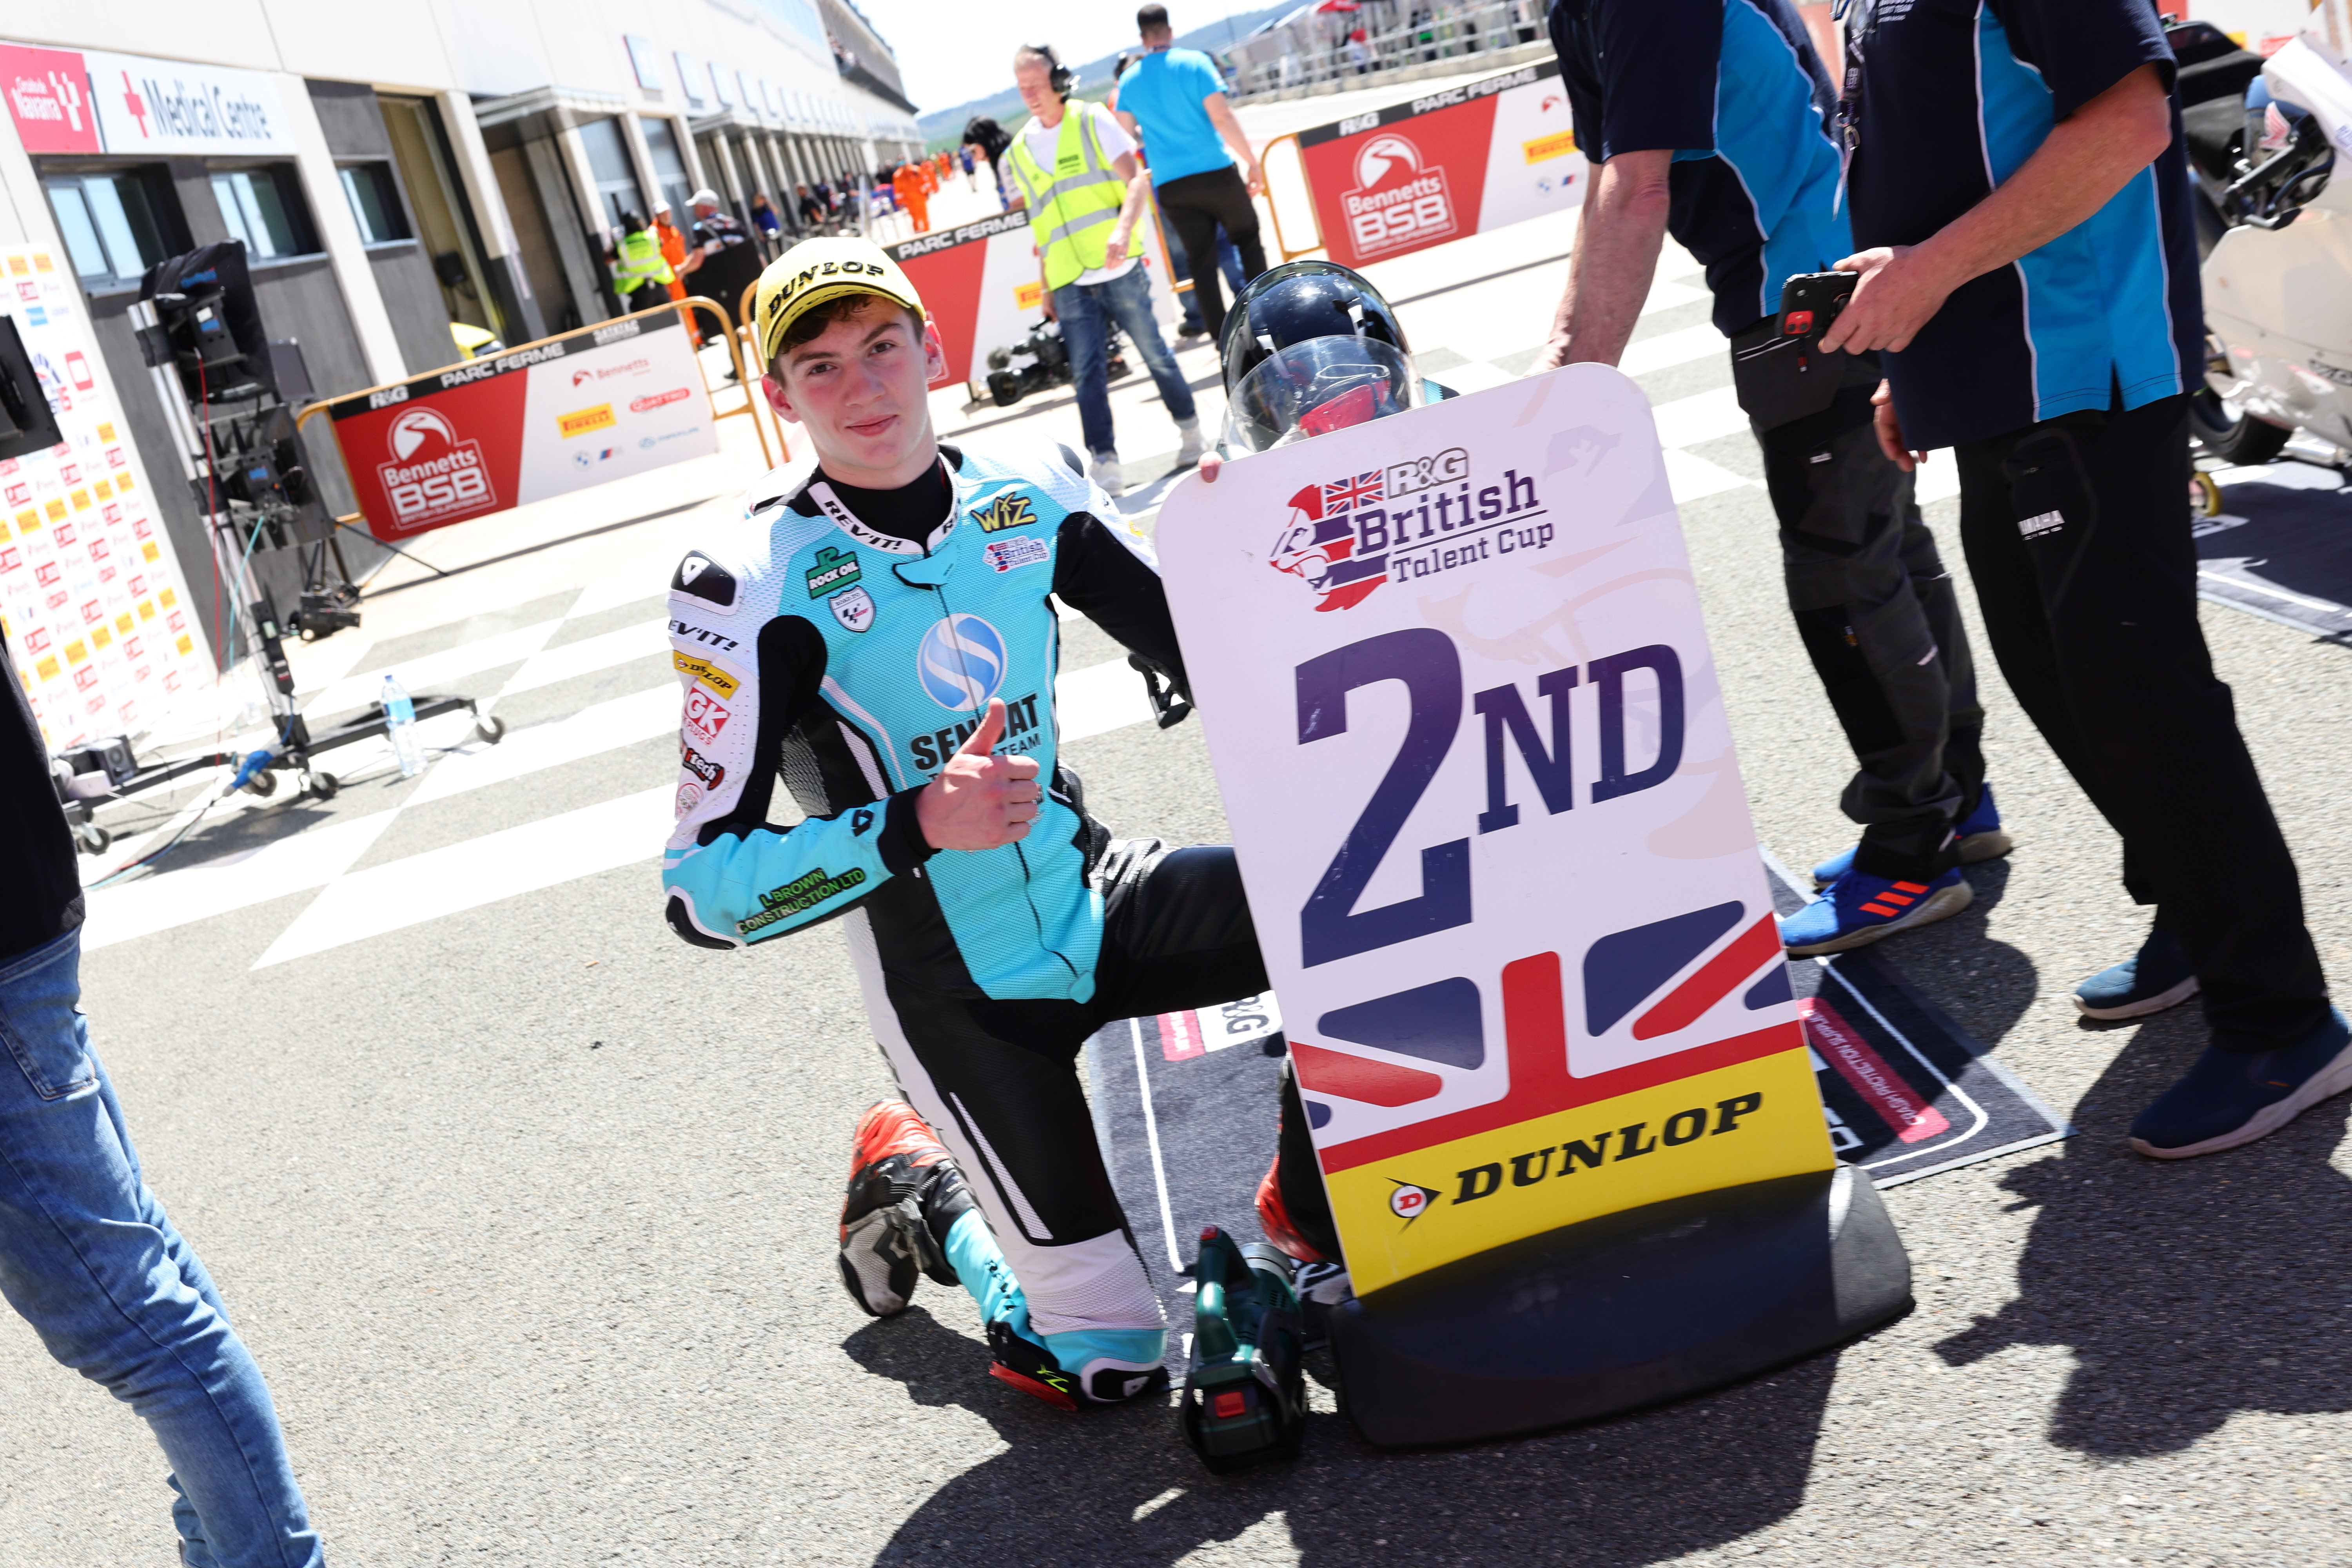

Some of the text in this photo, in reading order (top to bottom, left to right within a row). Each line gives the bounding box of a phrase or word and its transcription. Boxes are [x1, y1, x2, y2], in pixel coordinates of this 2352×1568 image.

[142, 78, 271, 139] Medical Centre
[1339, 112, 1379, 137] R&G
[1412, 88, 1467, 115] PARC
[1347, 176, 1442, 216] Bennetts
[1352, 194, 1449, 245] BSB
[897, 231, 953, 259] PARC
[768, 261, 884, 319] DUNLOP
[369, 385, 409, 409] R&G
[440, 363, 494, 388] PARC
[596, 358, 650, 379] Bennetts
[384, 449, 477, 487] Bennetts
[390, 467, 486, 515] BSB
[1387, 447, 1470, 499] R&G
[1354, 469, 1540, 556] British
[1003, 541, 1044, 559] British
[1391, 521, 1555, 584] Talent Cup
[808, 562, 859, 589] ROCK OIL
[668, 620, 739, 651] EV'IT!
[686, 692, 728, 736] GK
[910, 693, 1038, 771] SENAT
[1294, 628, 1684, 970] 2ND
[737, 869, 864, 935] CONSTRUCTION LTD
[760, 870, 827, 908] L BROWN
[1834, 1042, 1895, 1100] PROTECTION
[1450, 1091, 1764, 1206] DUNLOP
